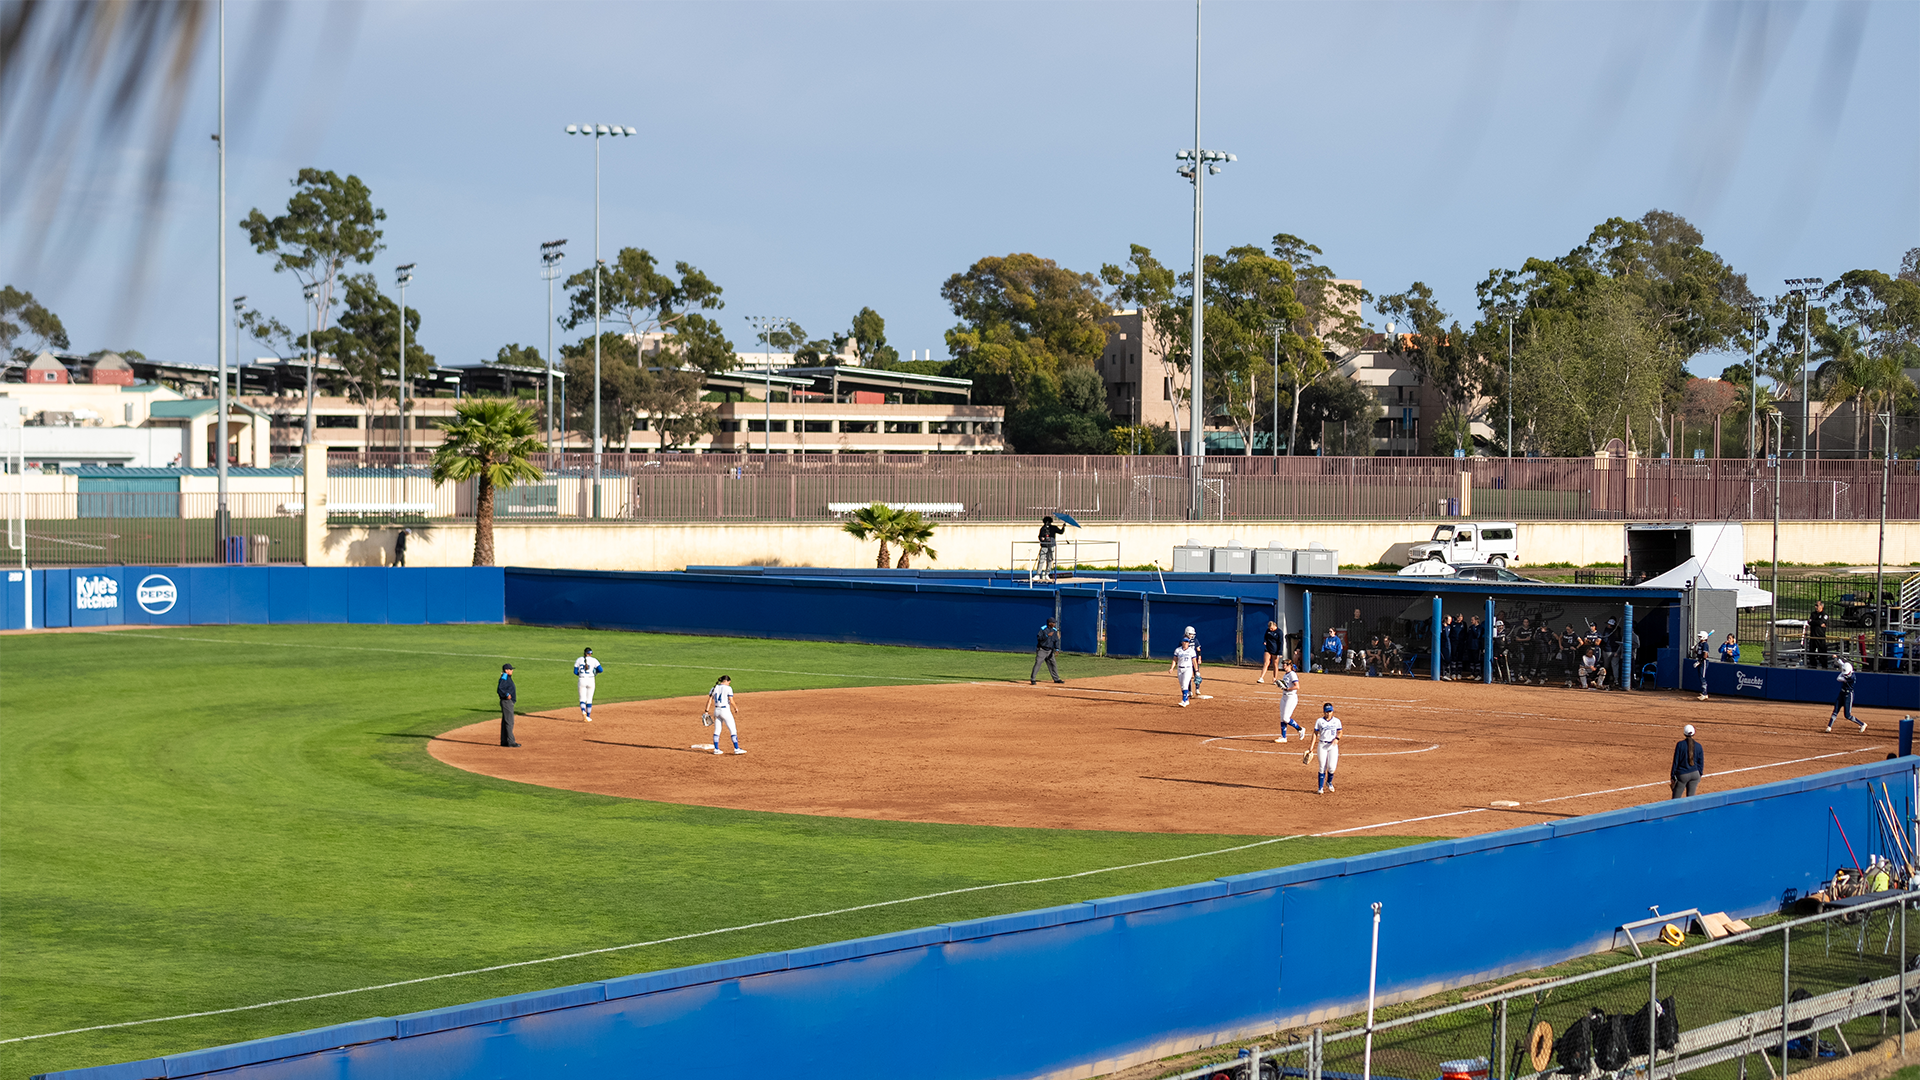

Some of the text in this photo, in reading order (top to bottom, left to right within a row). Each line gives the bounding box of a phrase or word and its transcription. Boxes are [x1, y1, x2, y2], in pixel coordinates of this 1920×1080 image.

[76, 576, 118, 598] Kyle's
[140, 590, 174, 598] PEPSI
[1736, 670, 1763, 690] Gauchos
